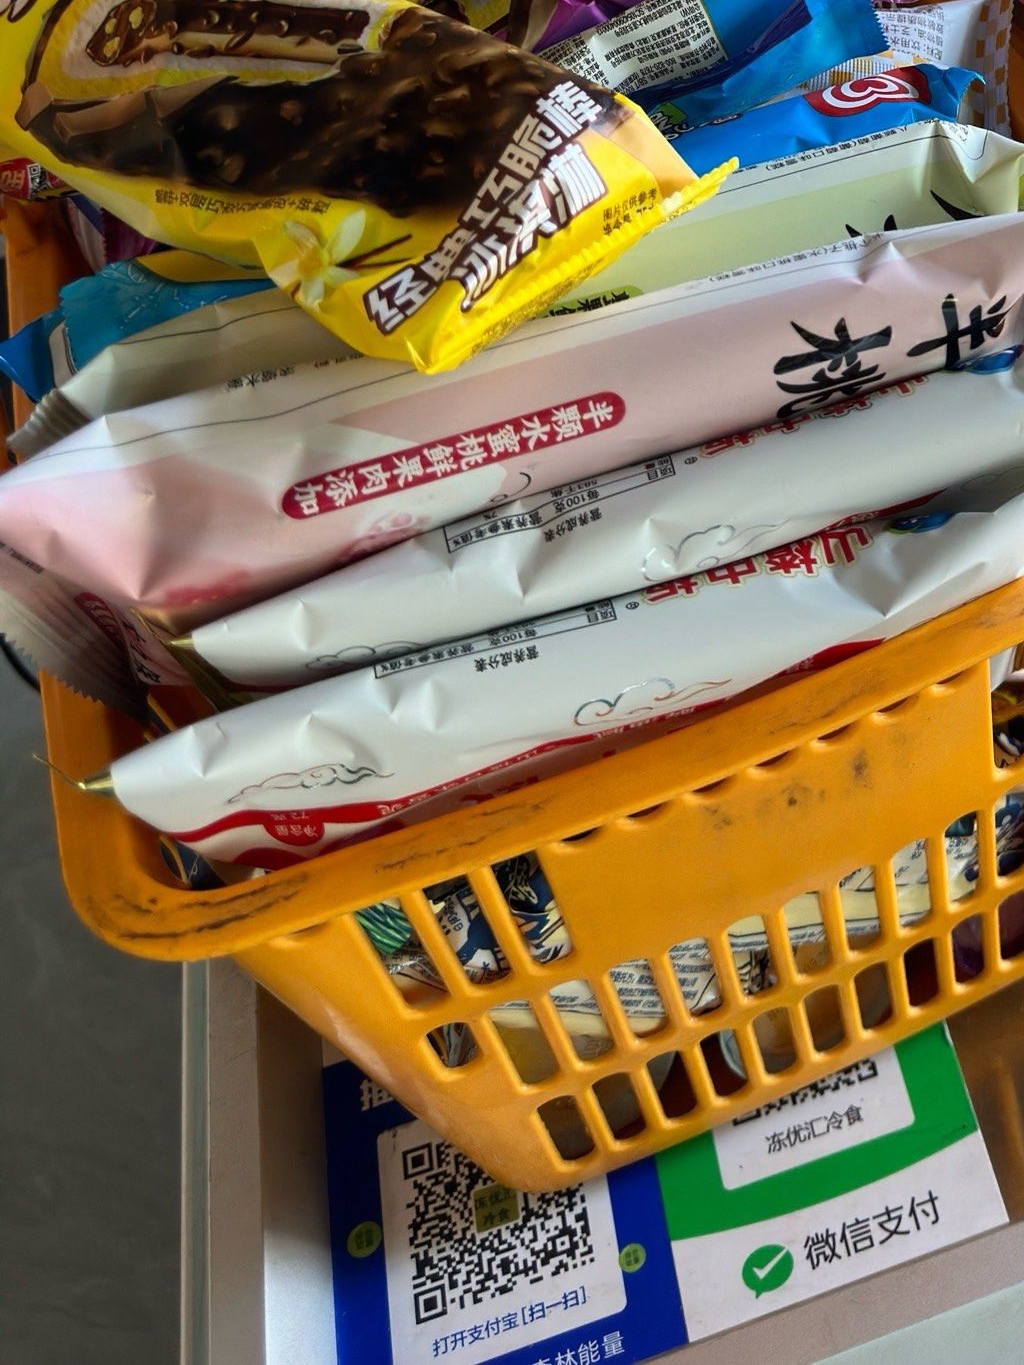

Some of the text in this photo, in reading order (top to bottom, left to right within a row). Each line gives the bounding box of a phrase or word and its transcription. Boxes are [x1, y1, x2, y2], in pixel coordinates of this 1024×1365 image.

[293, 401, 612, 513] 半颗水蜜桃鲜果肉添加
[543, 508, 602, 542] 营养成分表
[473, 645, 540, 672] 营养成分表
[765, 1103, 864, 1154] 冻优汇冷食
[803, 1189, 940, 1270] 微信支付
[432, 1285, 588, 1358] 打开支付宝[扫一扫]
